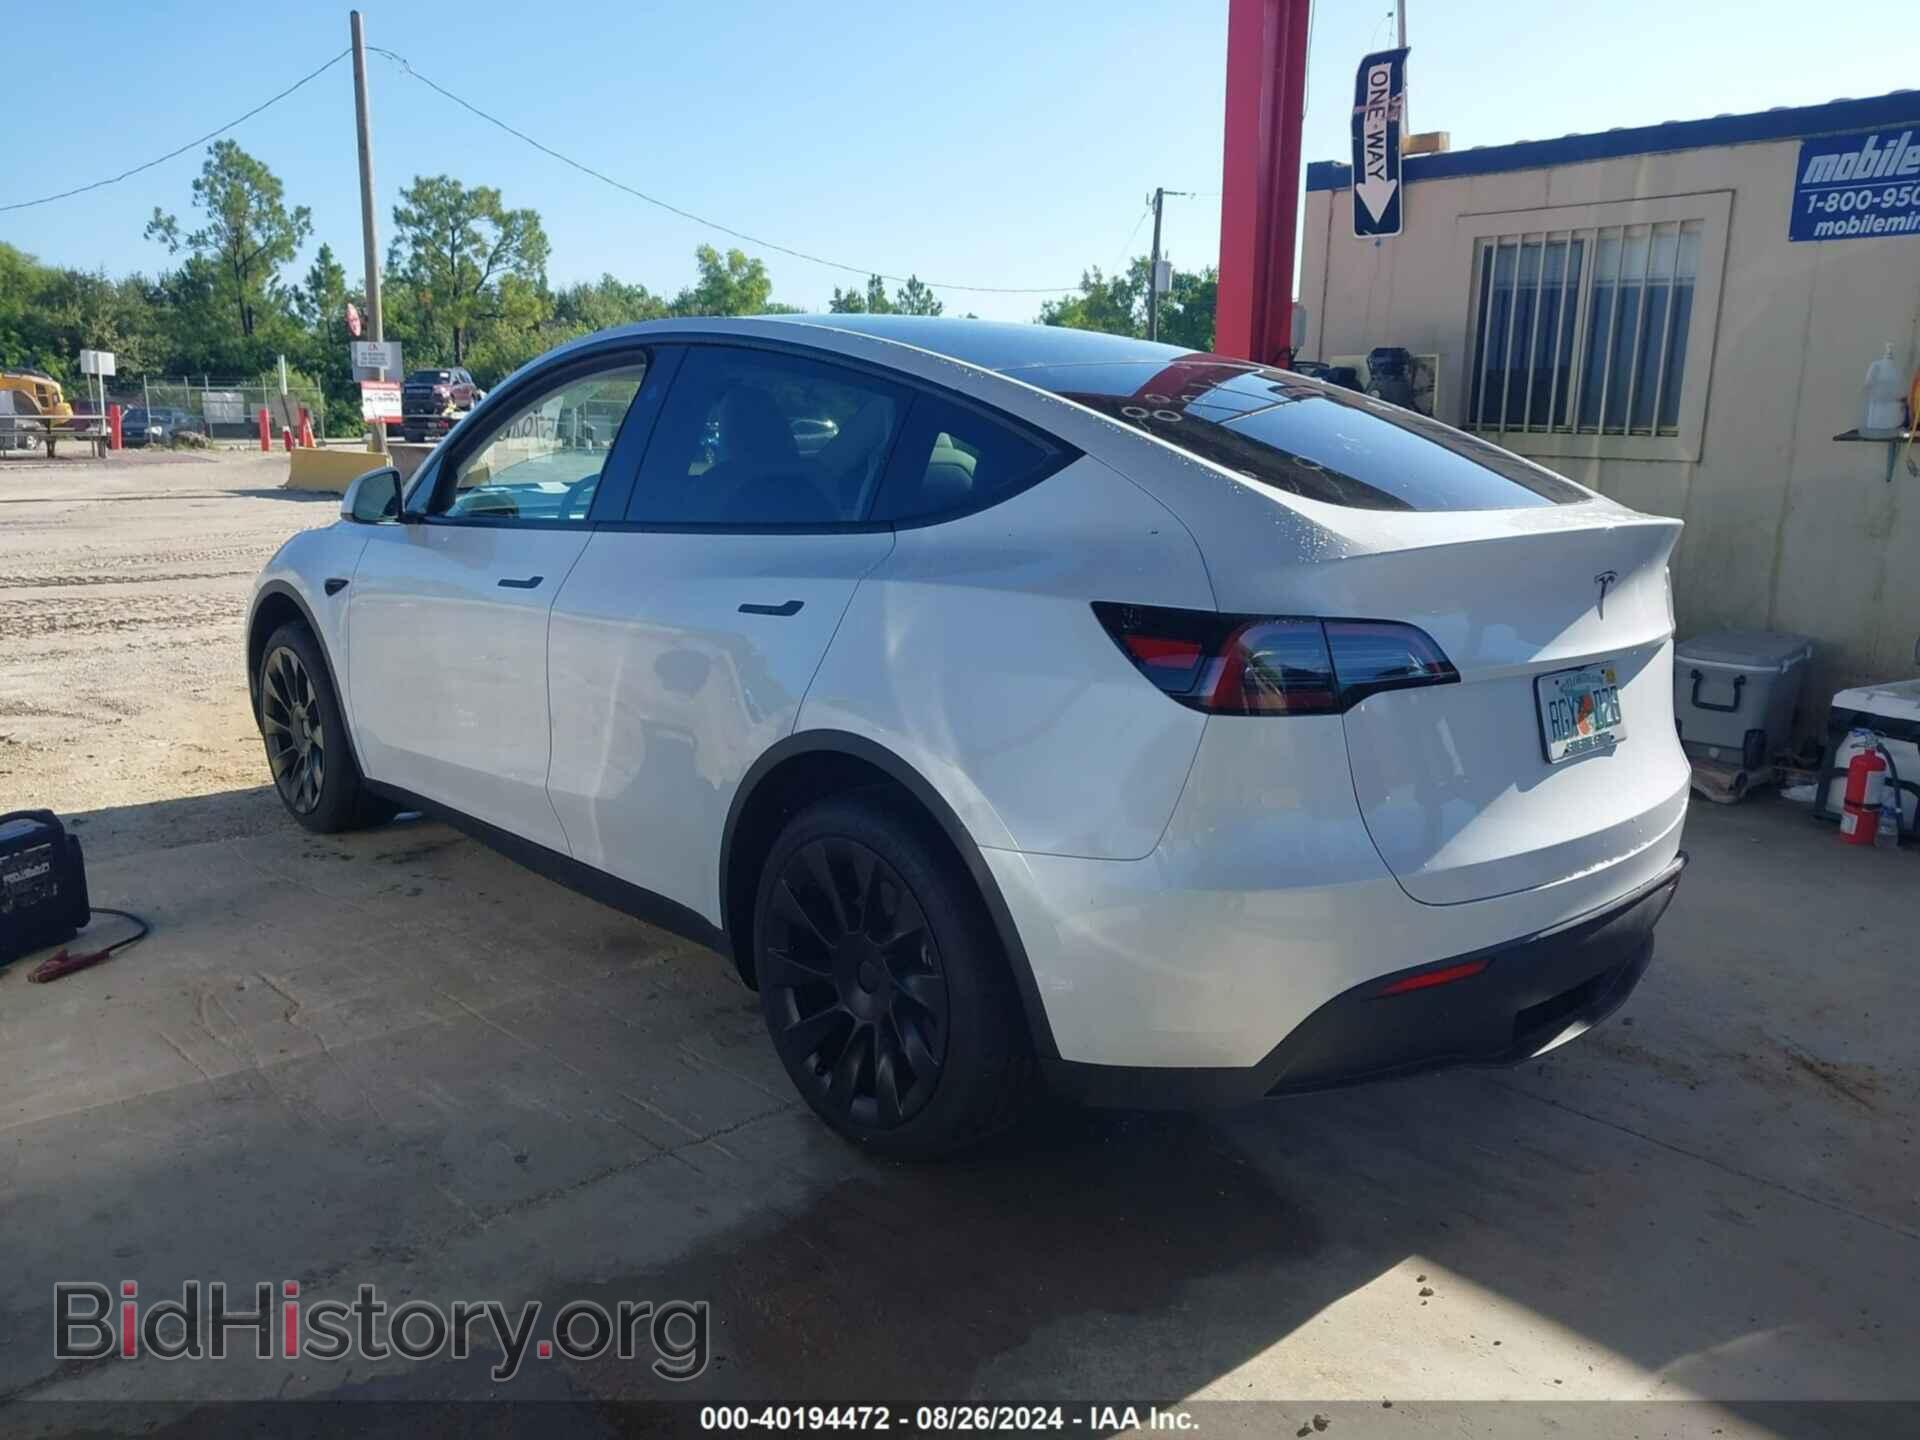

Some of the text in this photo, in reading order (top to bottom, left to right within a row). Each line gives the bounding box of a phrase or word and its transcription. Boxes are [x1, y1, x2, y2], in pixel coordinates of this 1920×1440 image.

[1367, 71, 1388, 181] ONE WAY
[1802, 131, 1920, 184] mobile
